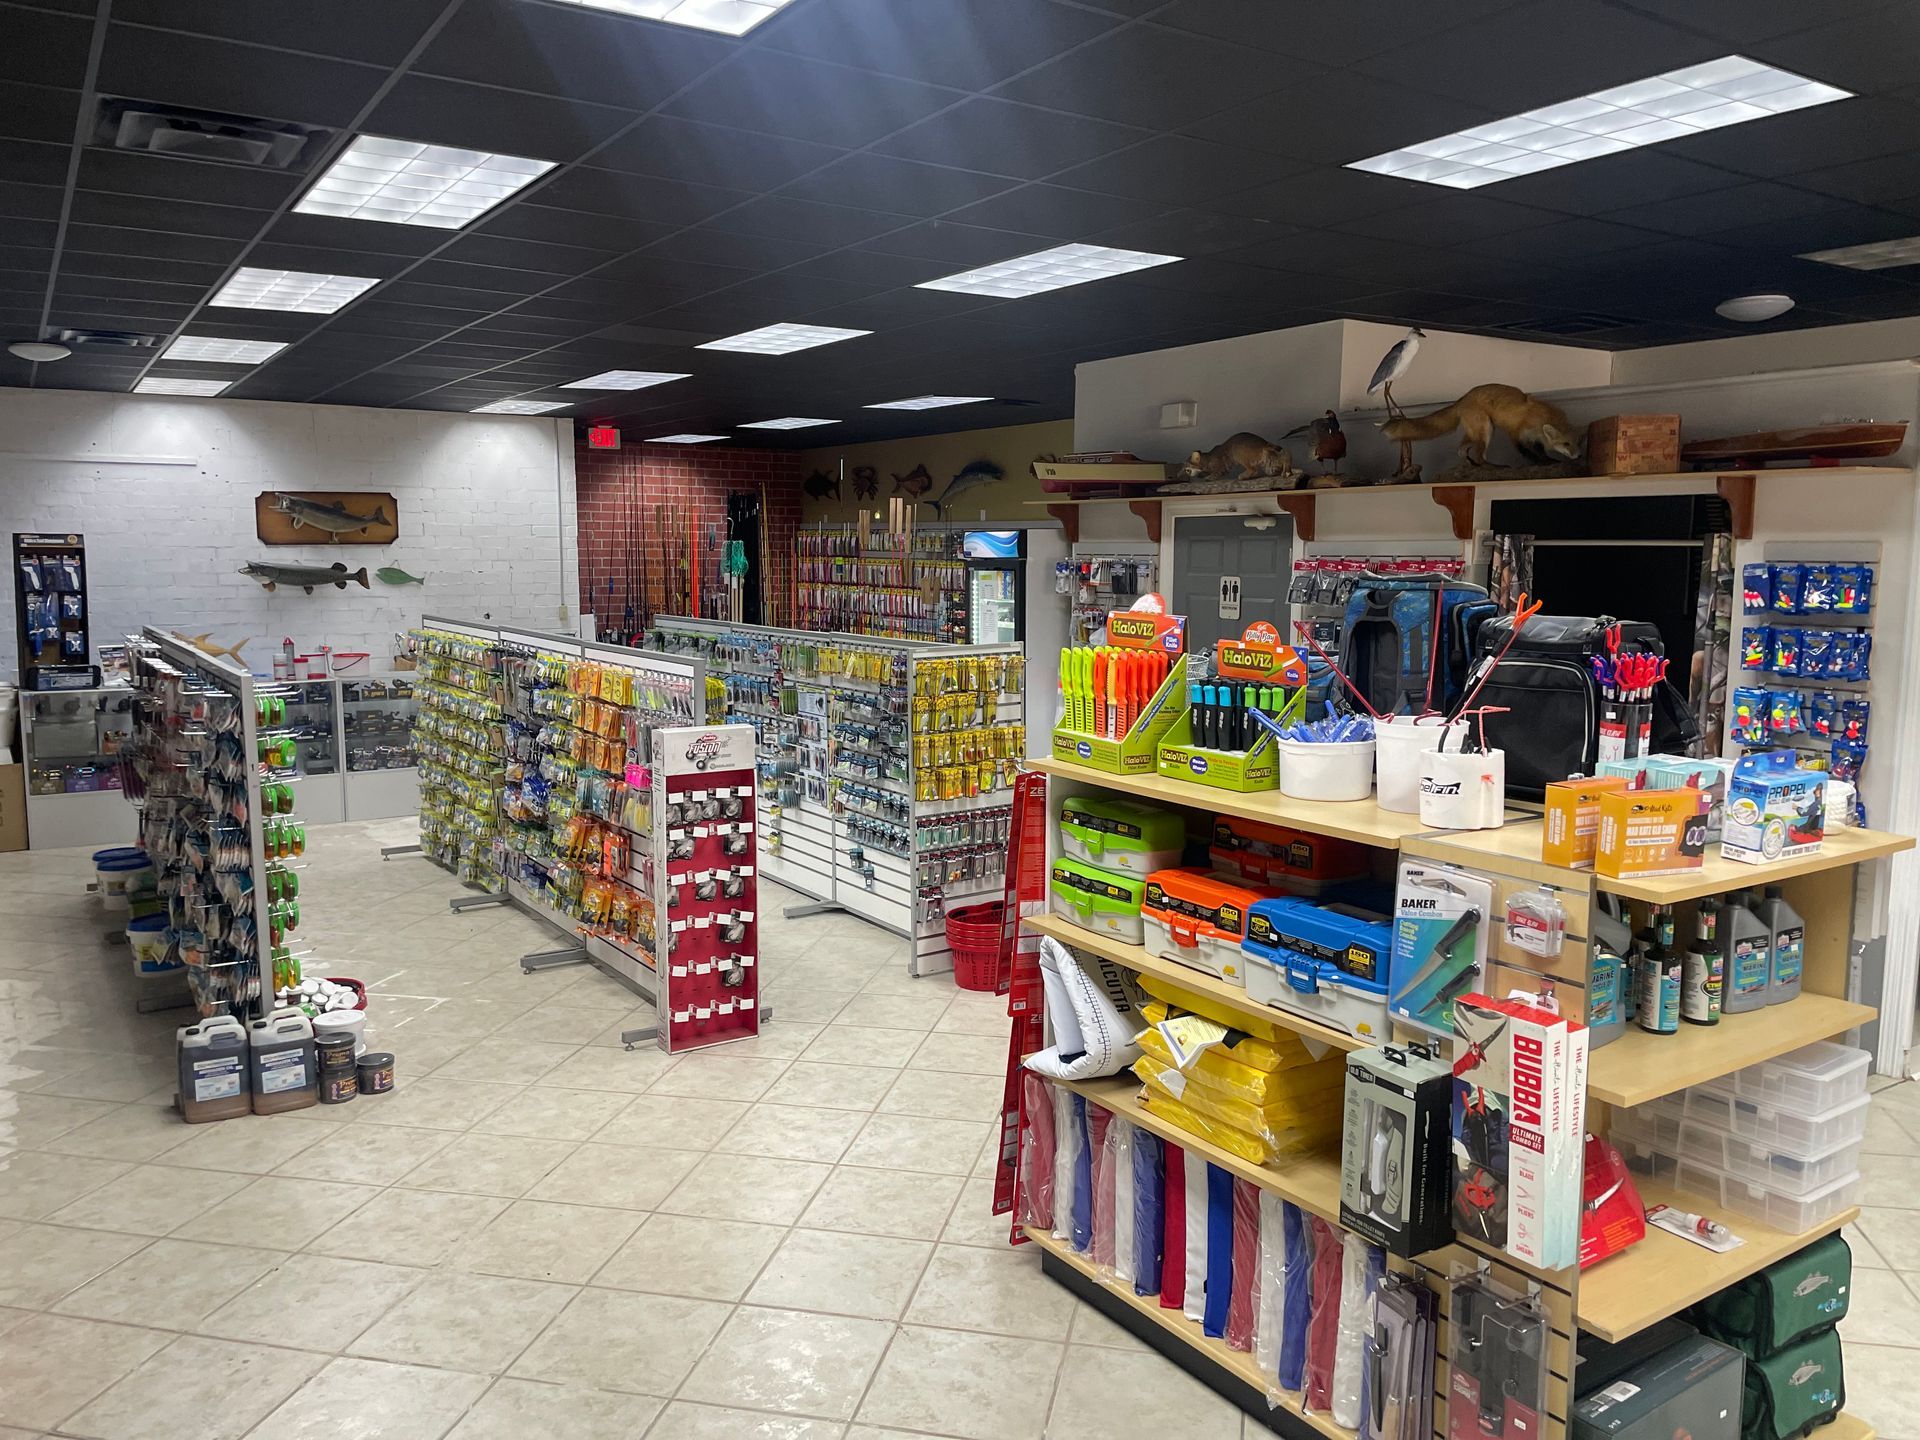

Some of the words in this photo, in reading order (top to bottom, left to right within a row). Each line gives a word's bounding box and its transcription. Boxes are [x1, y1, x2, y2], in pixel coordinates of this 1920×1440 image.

[1401, 898, 1436, 909] BAKER
[1097, 955, 1131, 1015] LCUTTA
[1553, 1040, 1561, 1051] THE
[1514, 1033, 1543, 1126] BUBBA
[1552, 1087, 1560, 1134] LIFESTYLE
[1572, 1093, 1580, 1137] LIFESTYLE
[1512, 1127, 1542, 1144] ULTIMATE
[1512, 1134, 1531, 1147] COMBO
[1532, 1141, 1542, 1150] SET
[1519, 1168, 1534, 1181] BLADE
[1518, 1207, 1534, 1219] PLIERS
